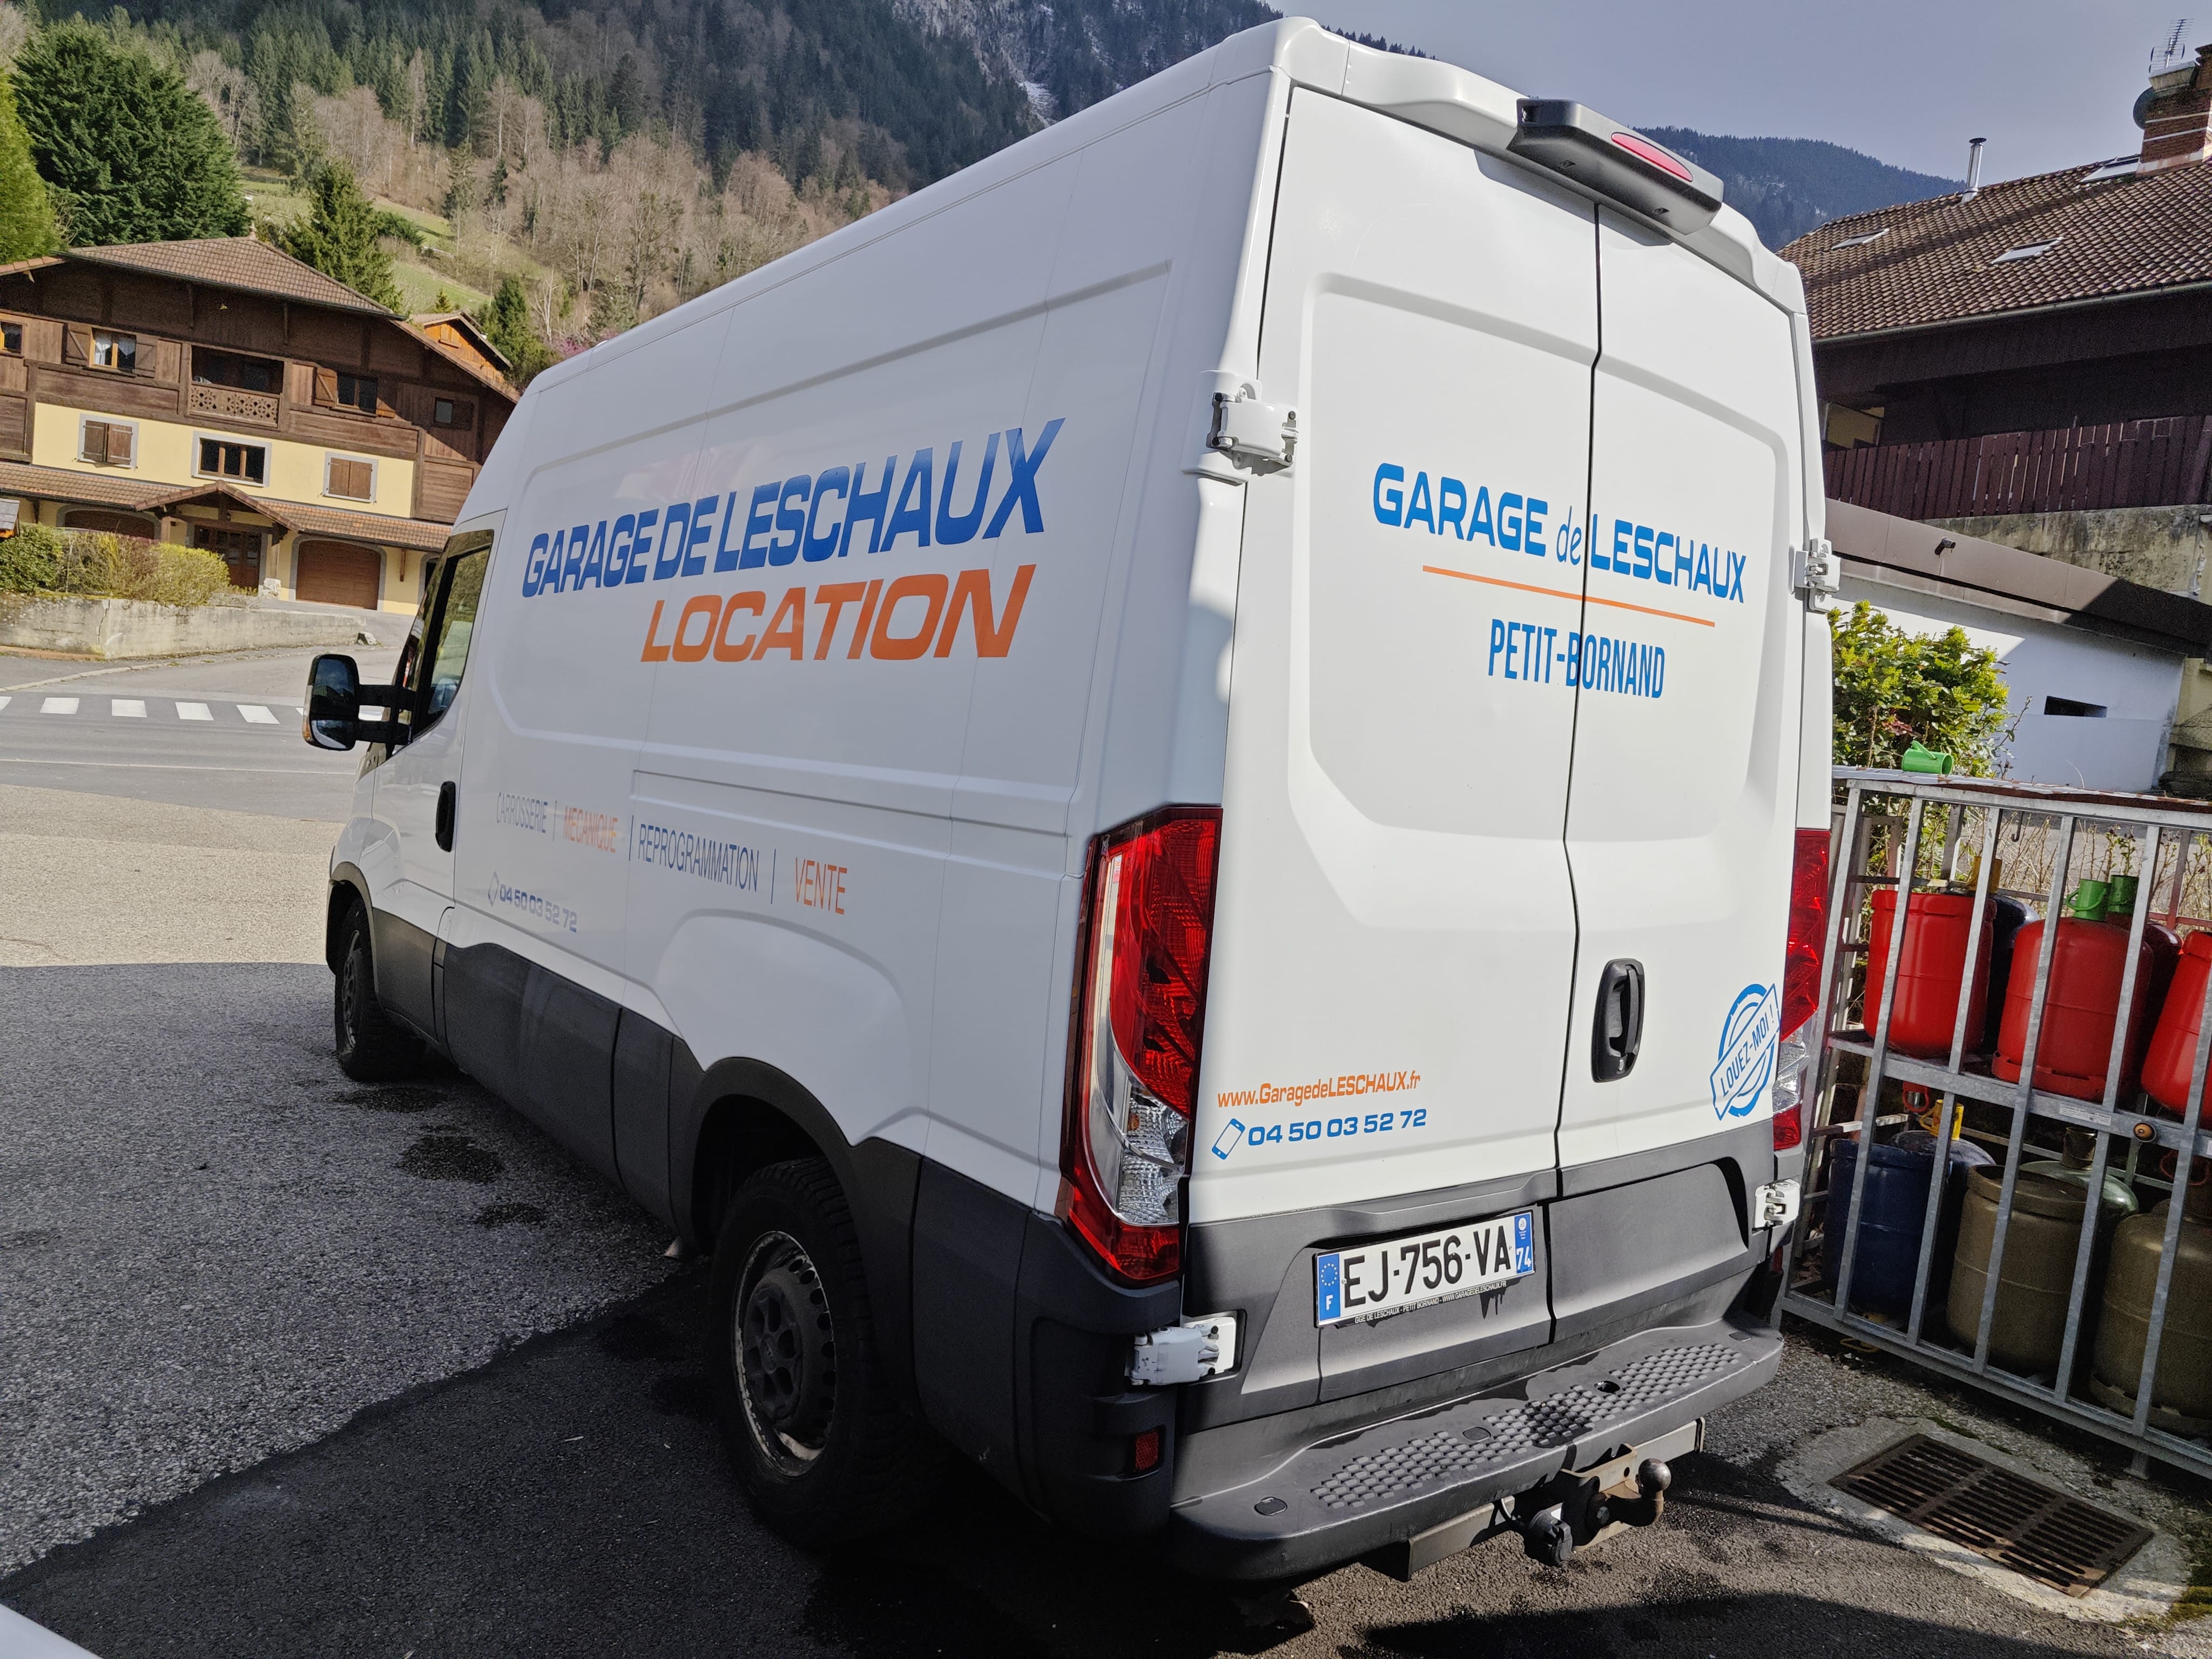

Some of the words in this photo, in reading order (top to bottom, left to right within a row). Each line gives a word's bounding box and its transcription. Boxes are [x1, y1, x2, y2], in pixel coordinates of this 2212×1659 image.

[522, 509, 659, 597] GARAGE
[653, 495, 719, 581] DE
[713, 417, 1065, 572] LESCHAUX
[1373, 463, 1548, 557] GARAGE
[1556, 505, 1582, 565] de
[1590, 514, 1746, 603] LESCHAUX
[640, 564, 1036, 662] LOCATION
[1488, 619, 1665, 699] PETIT-BORNAND
[496, 792, 548, 833] CARROSSERIE
[563, 806, 618, 853] MECANIQUE
[638, 824, 759, 892] REPROGRAMMATION
[500, 884, 512, 905] 04
[514, 889, 528, 911] 50
[529, 895, 543, 918] 03
[545, 901, 559, 925] 52
[562, 908, 577, 933] 72
[795, 857, 847, 915] VENTE
[1721, 1011, 1769, 1097] LOUEZ-MOI
[1217, 1070, 1420, 1108] www.GaragedeLESCHAUX.fr
[1248, 1125, 1283, 1146] 04
[1288, 1121, 1322, 1142] 50
[1327, 1116, 1358, 1137] 03
[1364, 1112, 1394, 1133] 52
[1400, 1109, 1427, 1129] 72
[1344, 1225, 1511, 1308] EJ-756-VA
[1516, 1246, 1532, 1270] 74
[1326, 1294, 1334, 1310] F
[1354, 1315, 1366, 1324] GGE
[1374, 1307, 1400, 1319] LESCHAUX
[1403, 1303, 1416, 1312] PETIT
[1417, 1297, 1439, 1309] BORNAND
[1442, 1280, 1507, 1303] WWW.GARAGEDELESCHAUX.FR
